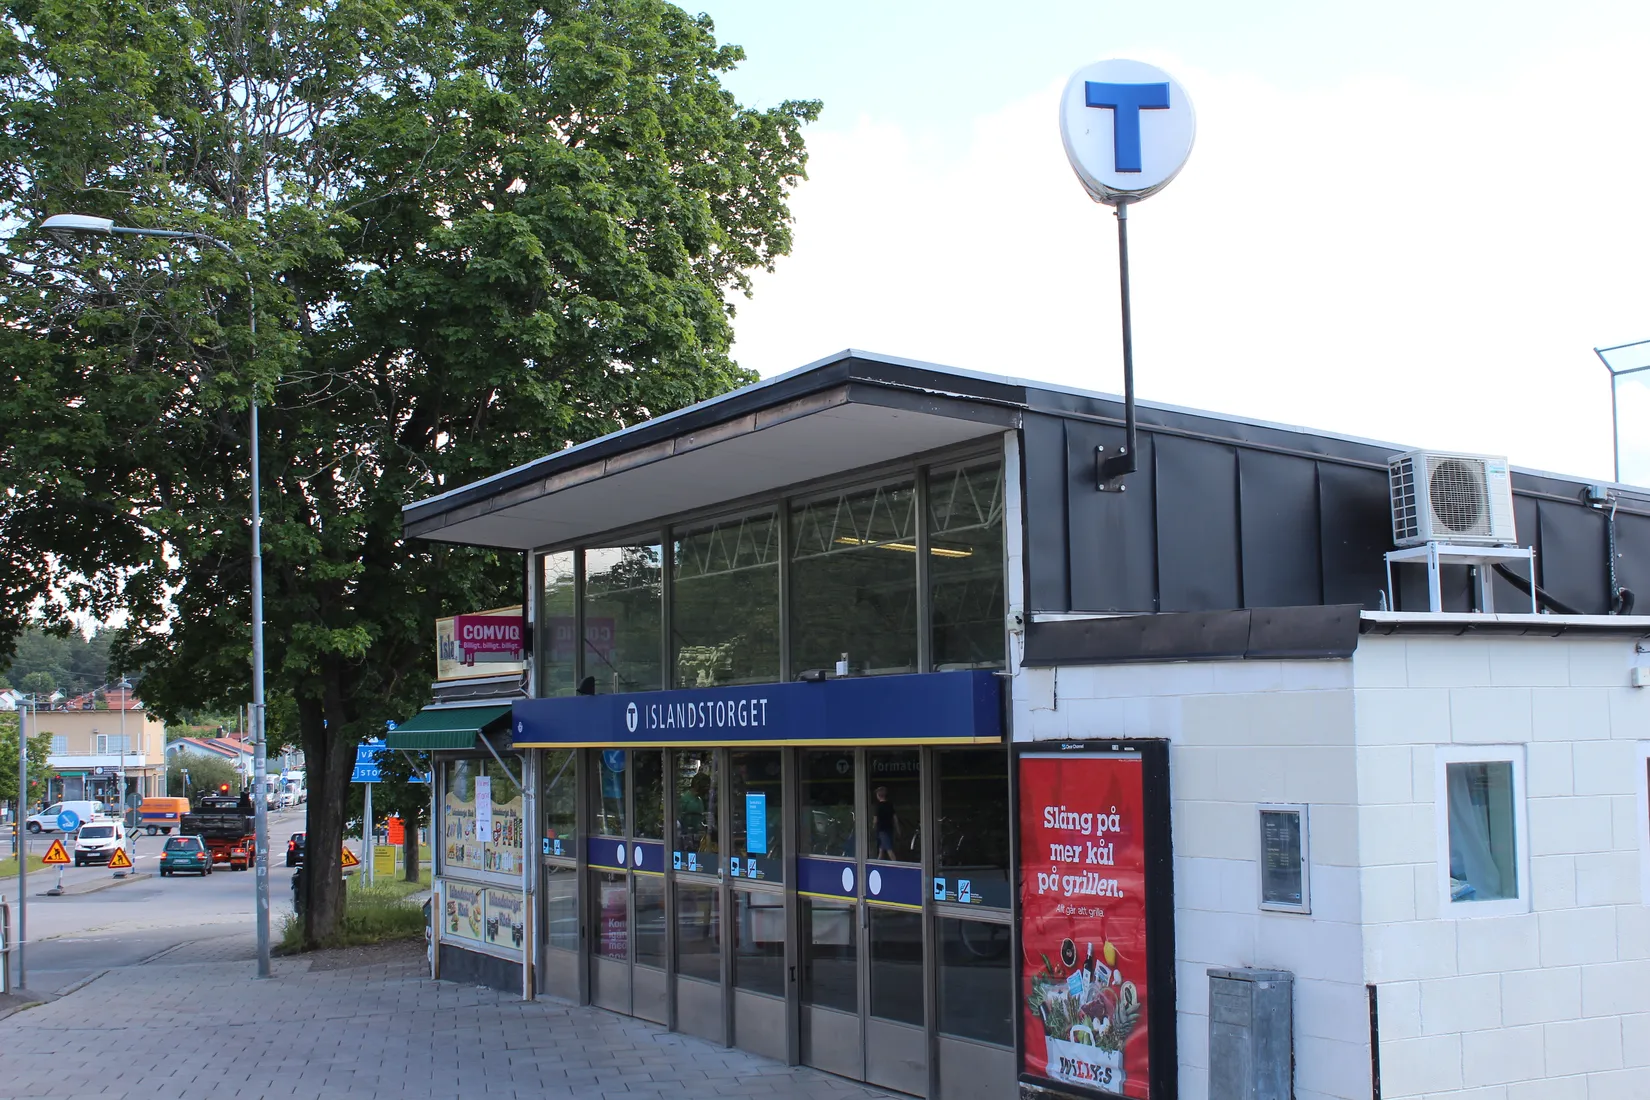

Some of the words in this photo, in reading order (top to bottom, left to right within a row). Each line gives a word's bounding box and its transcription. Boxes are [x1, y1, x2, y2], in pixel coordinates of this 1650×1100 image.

[1085, 80, 1170, 173] T
[463, 625, 520, 640] COMVIQ
[483, 642, 501, 650] billigt.
[501, 642, 520, 650] billigt.
[645, 699, 768, 729] ISLANDSTORGET
[1044, 805, 1093, 835] Släng
[1096, 805, 1120, 836] på
[1050, 843, 1082, 863] mer
[1085, 839, 1114, 866] kål
[1037, 865, 1059, 894] på
[1062, 869, 1124, 898] grillen.
[1056, 904, 1065, 913] Allt
[1066, 904, 1076, 916] går
[1077, 906, 1087, 915] att
